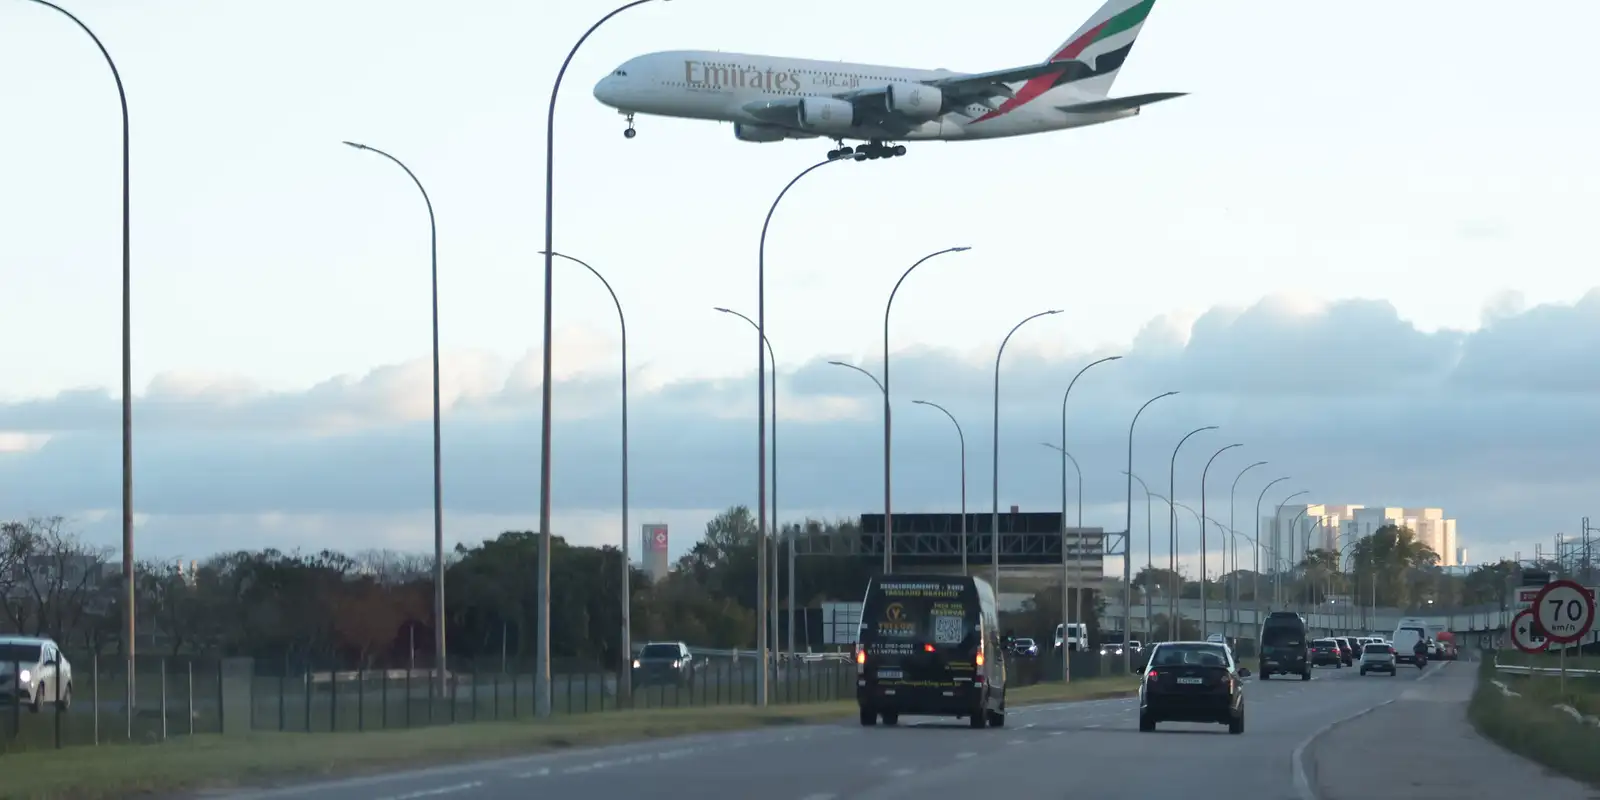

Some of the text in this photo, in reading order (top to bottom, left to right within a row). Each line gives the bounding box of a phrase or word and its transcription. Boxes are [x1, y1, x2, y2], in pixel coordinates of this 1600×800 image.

[685, 60, 801, 92] Emirates
[1549, 599, 1582, 621] 70
[1551, 624, 1576, 632] km/h
